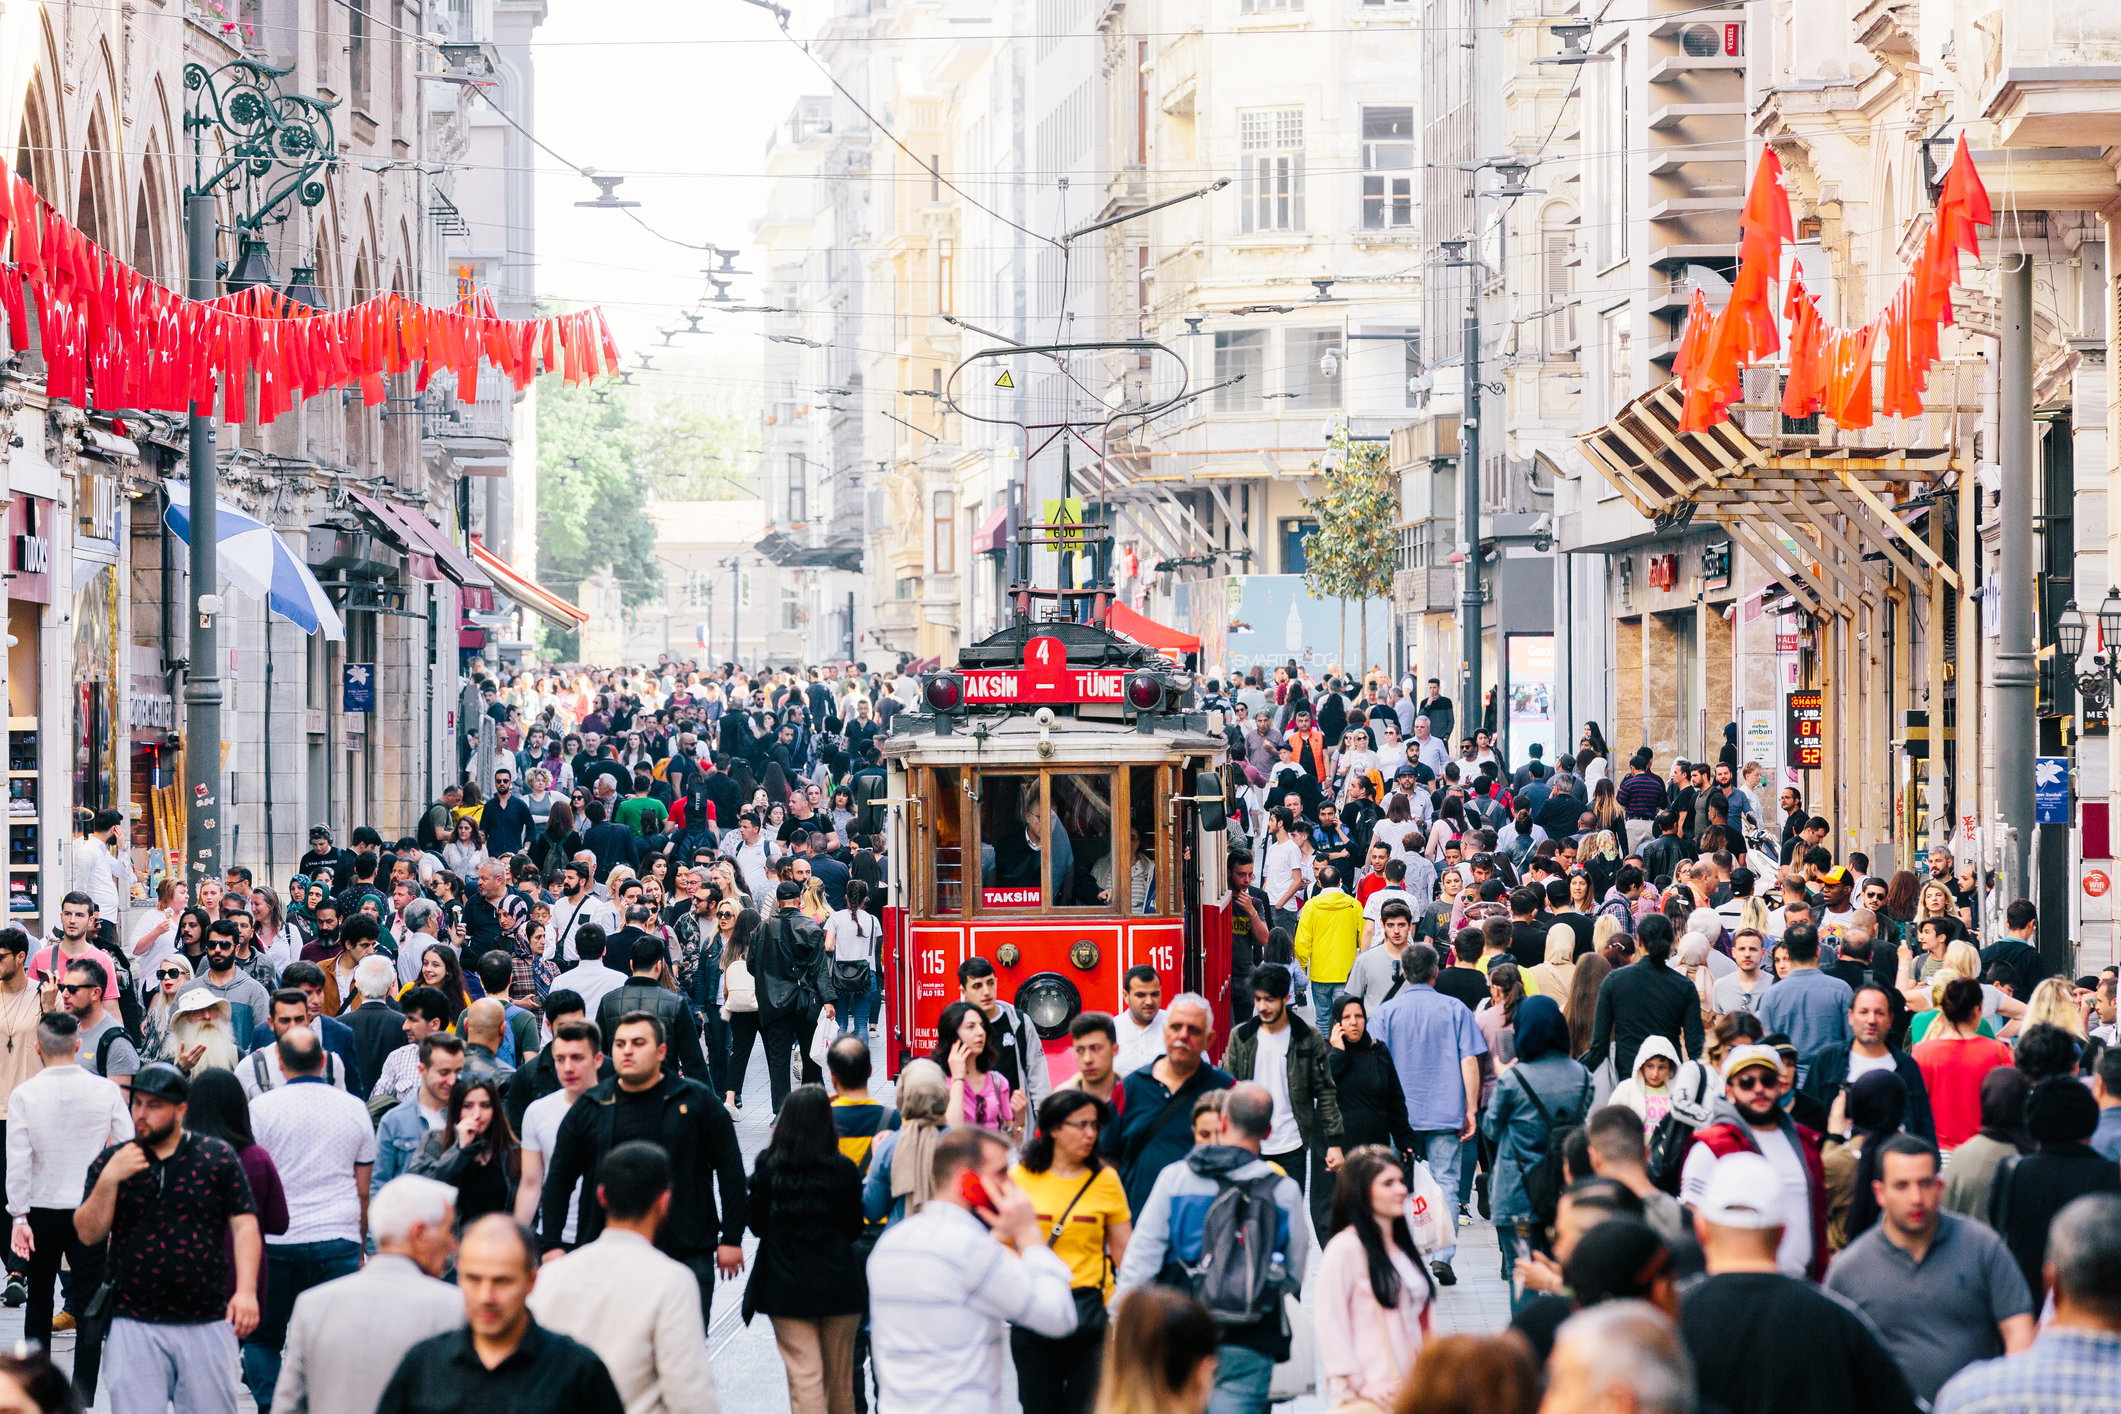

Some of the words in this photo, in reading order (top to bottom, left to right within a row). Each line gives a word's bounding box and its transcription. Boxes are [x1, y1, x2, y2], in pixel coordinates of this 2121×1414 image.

[1036, 640, 1049, 665] 4
[963, 672, 1018, 697] TAKSİM
[984, 890, 1040, 903] TAKSİM
[921, 950, 945, 974] 115
[1149, 946, 1173, 970] 115
